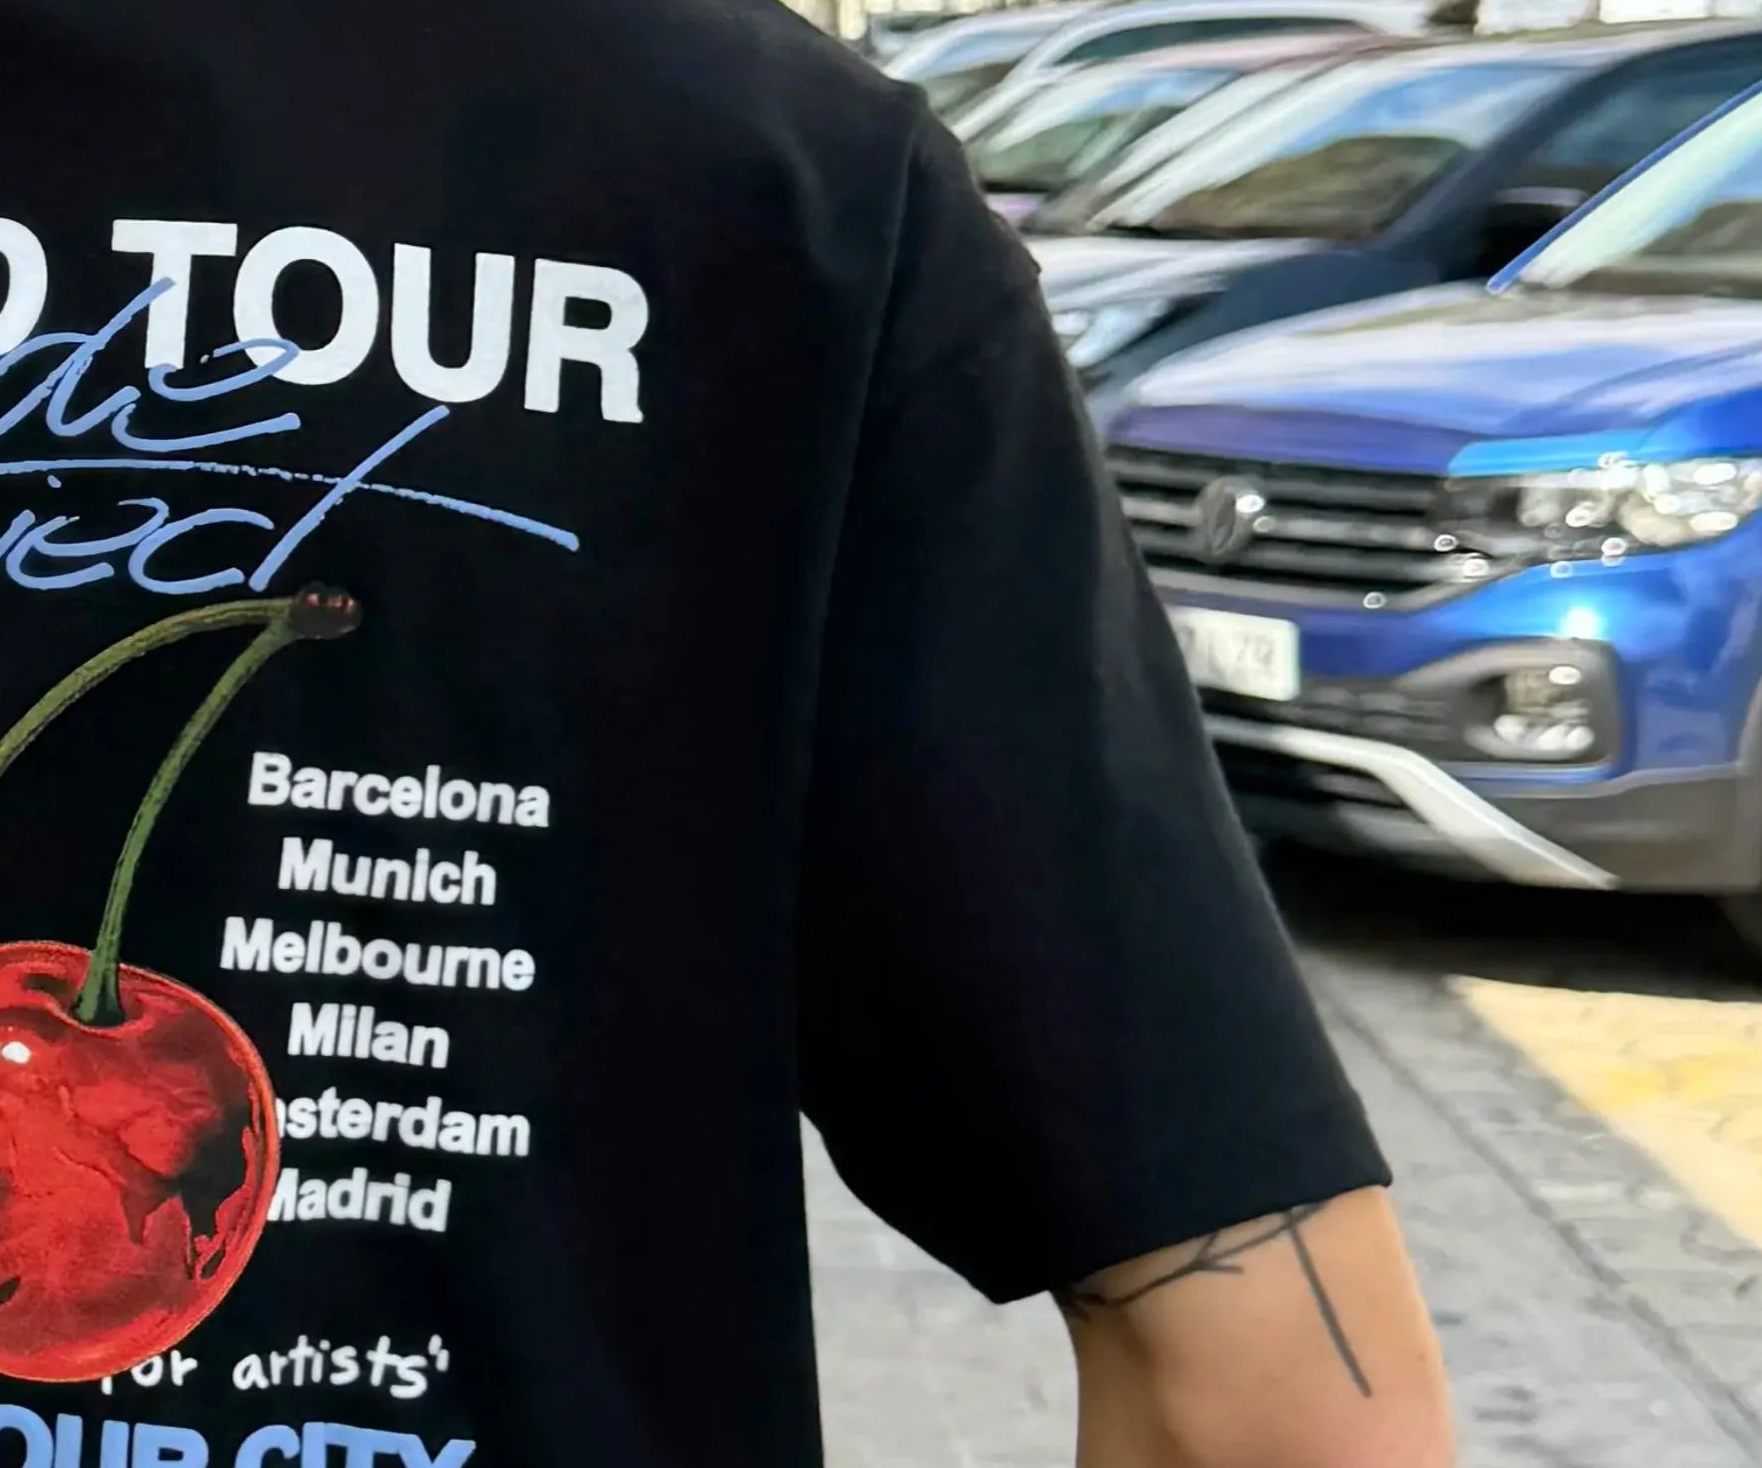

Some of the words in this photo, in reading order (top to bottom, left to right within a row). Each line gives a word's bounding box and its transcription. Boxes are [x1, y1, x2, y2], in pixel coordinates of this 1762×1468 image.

[112, 217, 649, 424] TOUR
[247, 751, 550, 828] Barcelona
[278, 836, 496, 906] Munich
[219, 916, 536, 991] Melbourne
[287, 1002, 450, 1069] Milan
[275, 1086, 531, 1157] sterdam
